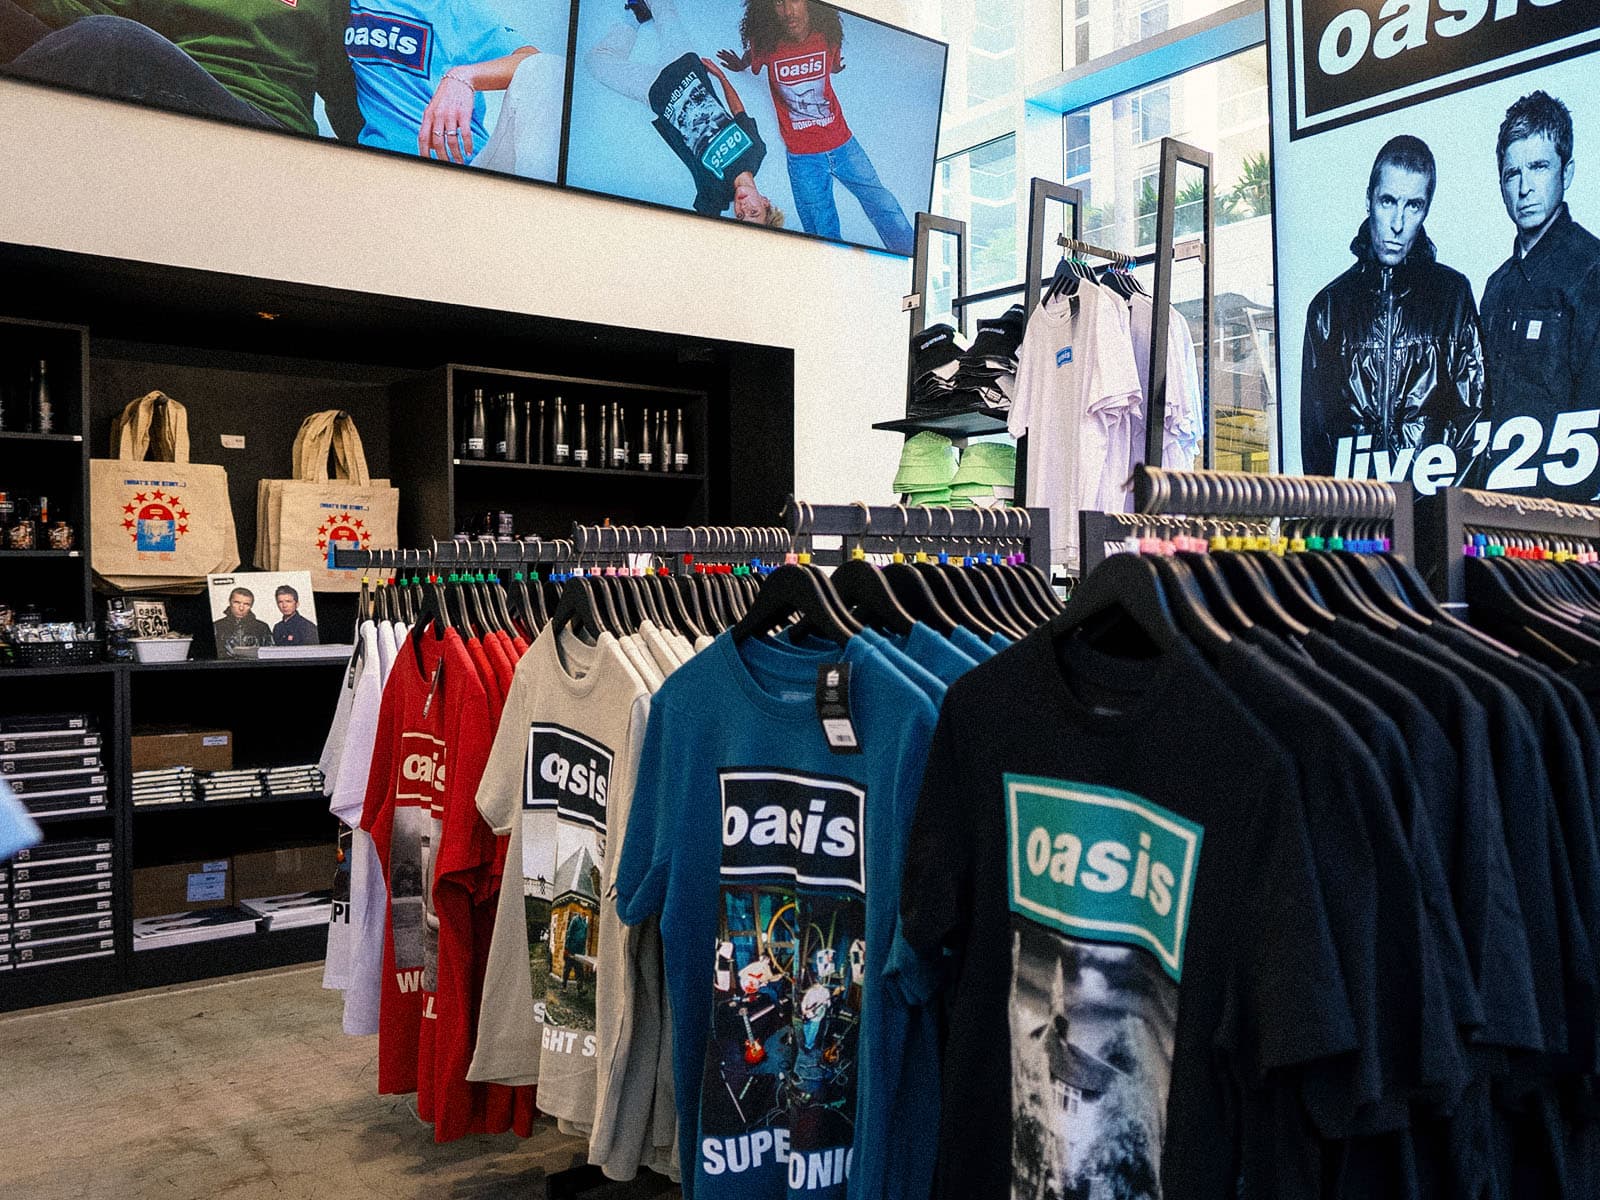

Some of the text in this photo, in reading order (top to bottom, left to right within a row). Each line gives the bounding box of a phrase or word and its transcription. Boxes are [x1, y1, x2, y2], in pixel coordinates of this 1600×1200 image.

[344, 26, 418, 55] oasis
[1318, 0, 1563, 75] oas
[681, 71, 698, 88] LIVE
[779, 58, 823, 77] oasis
[711, 130, 743, 168] oasis
[1334, 434, 1457, 496] live
[722, 799, 856, 857] oasis
[1026, 827, 1175, 917] oasis
